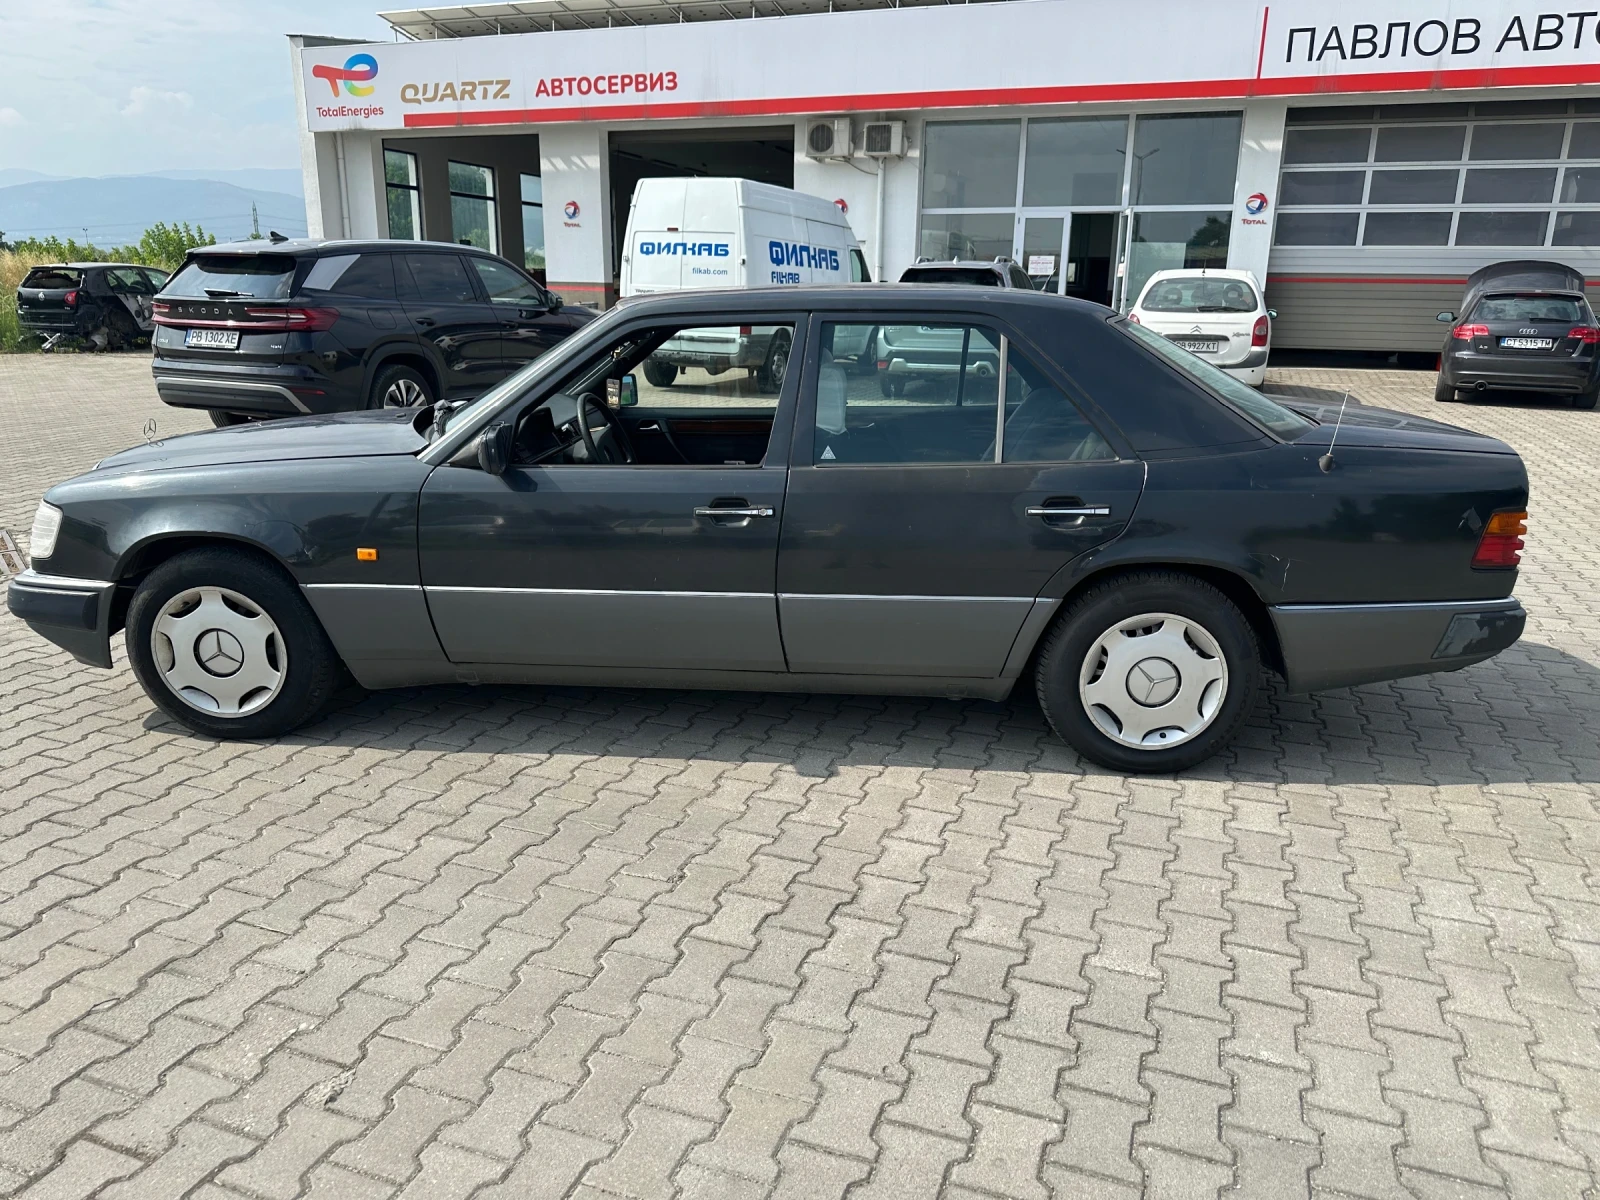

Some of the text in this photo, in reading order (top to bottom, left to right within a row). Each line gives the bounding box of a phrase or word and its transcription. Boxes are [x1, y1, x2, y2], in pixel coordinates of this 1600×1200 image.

[1285, 11, 1600, 63] ПАВЛОВ АВТ
[400, 78, 511, 106] QUARTZ
[535, 71, 678, 98] АВТОСЕРВИЗ
[316, 104, 384, 119] TotalEnergies
[639, 241, 730, 257] ФИЛКАБ
[769, 240, 840, 271] ФИЛКАБ
[692, 267, 728, 276] filkab.com
[771, 271, 800, 284] FILKAB
[191, 330, 237, 344] PB 1302 XE
[1188, 341, 1206, 350] 9927
[1206, 342, 1217, 350] KT
